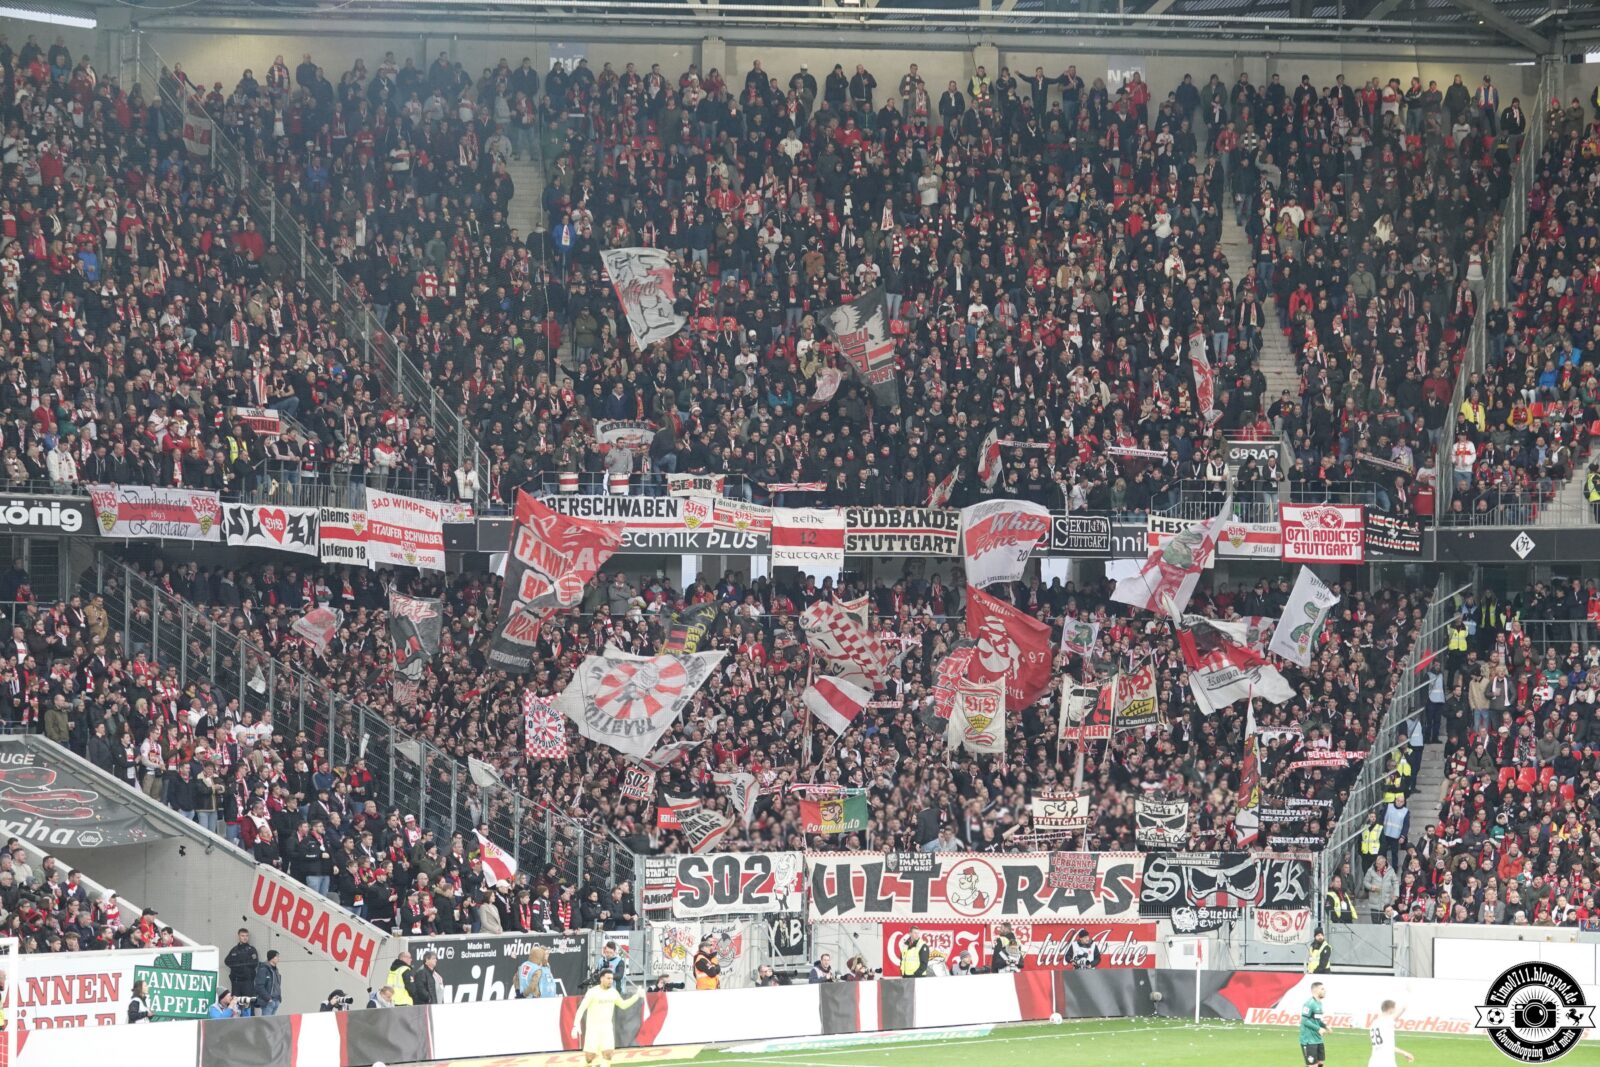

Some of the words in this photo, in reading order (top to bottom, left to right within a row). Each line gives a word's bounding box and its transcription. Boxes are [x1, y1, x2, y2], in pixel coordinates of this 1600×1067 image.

[321, 508, 350, 523] Glems
[372, 497, 390, 510] BAD
[392, 497, 439, 523] WIMPFEN
[846, 508, 960, 531] SÜDBANDE
[1151, 520, 1196, 534] HESS
[404, 530, 443, 545] SCHWABEN
[706, 531, 759, 549] PLUS
[800, 530, 817, 545] 12
[1287, 528, 1310, 543] 0711
[1312, 528, 1359, 543] ADDICTS
[1366, 534, 1420, 551] HALUNKEN
[322, 543, 353, 559] Inferno
[356, 546, 366, 560] 18
[846, 534, 957, 554] STUTTGART
[1294, 543, 1354, 556] STUTTGART
[0, 753, 36, 766] UGE
[1033, 817, 1088, 826] STUTTGART
[1051, 858, 1096, 867] VERBANNTE
[252, 874, 376, 977] URBACH
[461, 950, 497, 958] Schwarzwald
[1110, 932, 1149, 967] die
[138, 971, 214, 993] TANNEN
